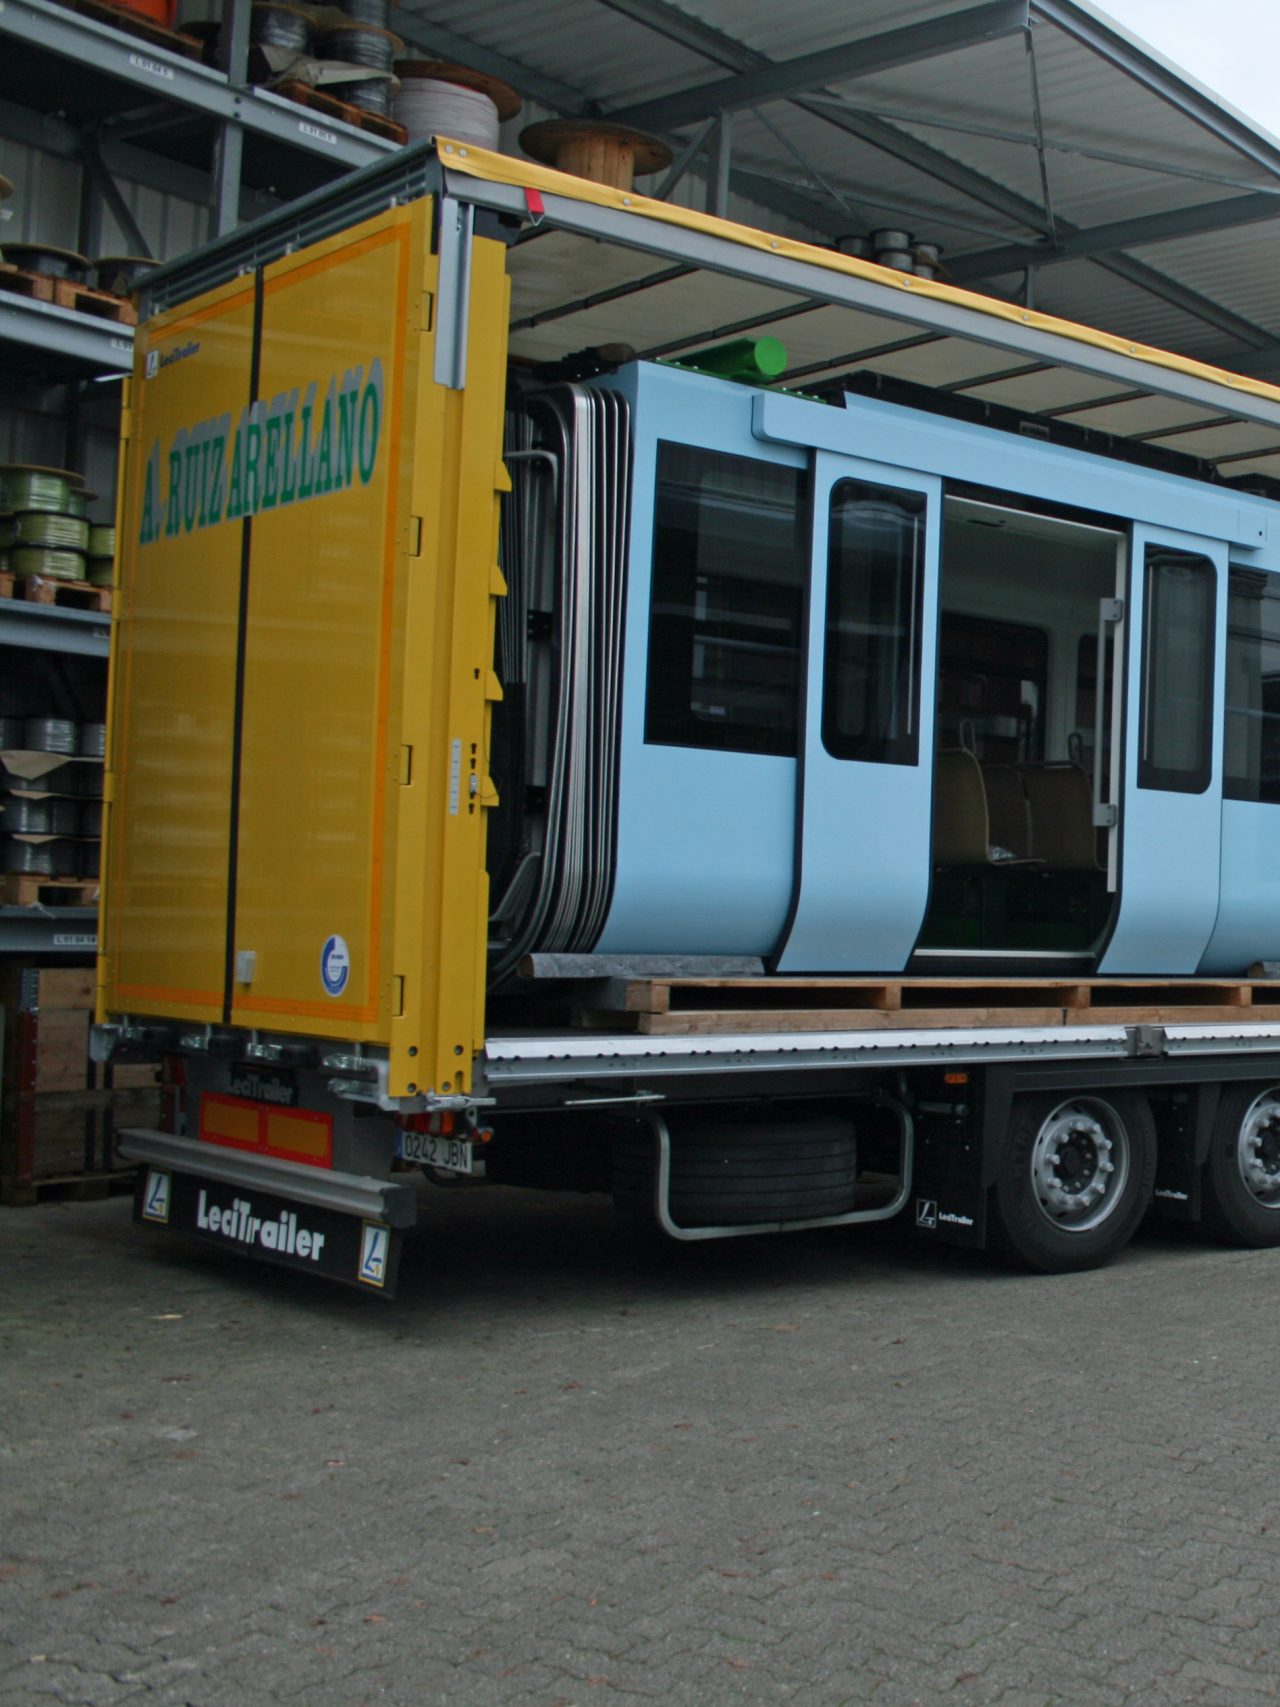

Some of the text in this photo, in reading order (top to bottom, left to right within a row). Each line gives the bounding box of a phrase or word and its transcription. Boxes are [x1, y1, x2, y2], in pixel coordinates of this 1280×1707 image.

[165, 420, 230, 538] RUIZ
[226, 365, 382, 520] ARELLANO
[404, 1134, 468, 1169] 0242 JBN
[196, 1188, 325, 1262] LeciTrailer
